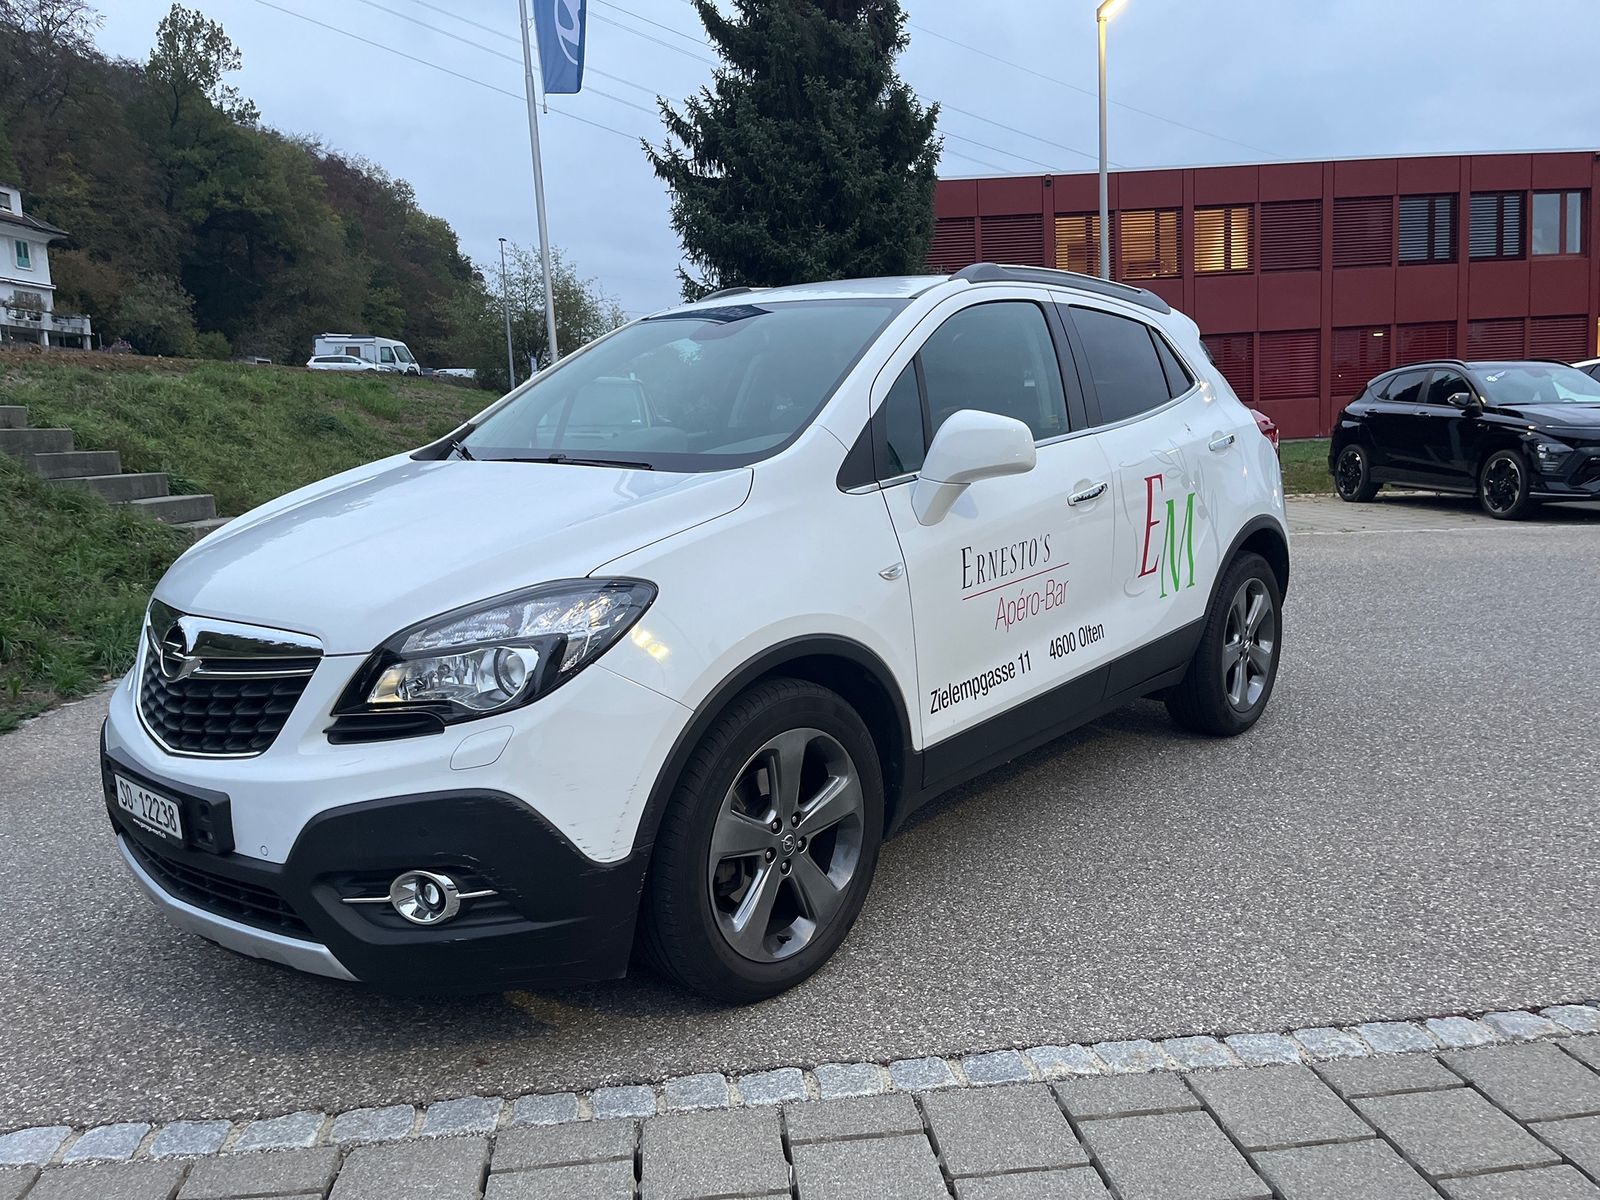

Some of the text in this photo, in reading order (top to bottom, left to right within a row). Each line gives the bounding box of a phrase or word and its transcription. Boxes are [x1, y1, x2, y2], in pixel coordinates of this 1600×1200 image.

[961, 533, 1051, 590] ERNESTO'S
[994, 579, 1069, 632] Apéro-Bar
[930, 623, 1105, 714] Zielempgasse 11 4600 Olten
